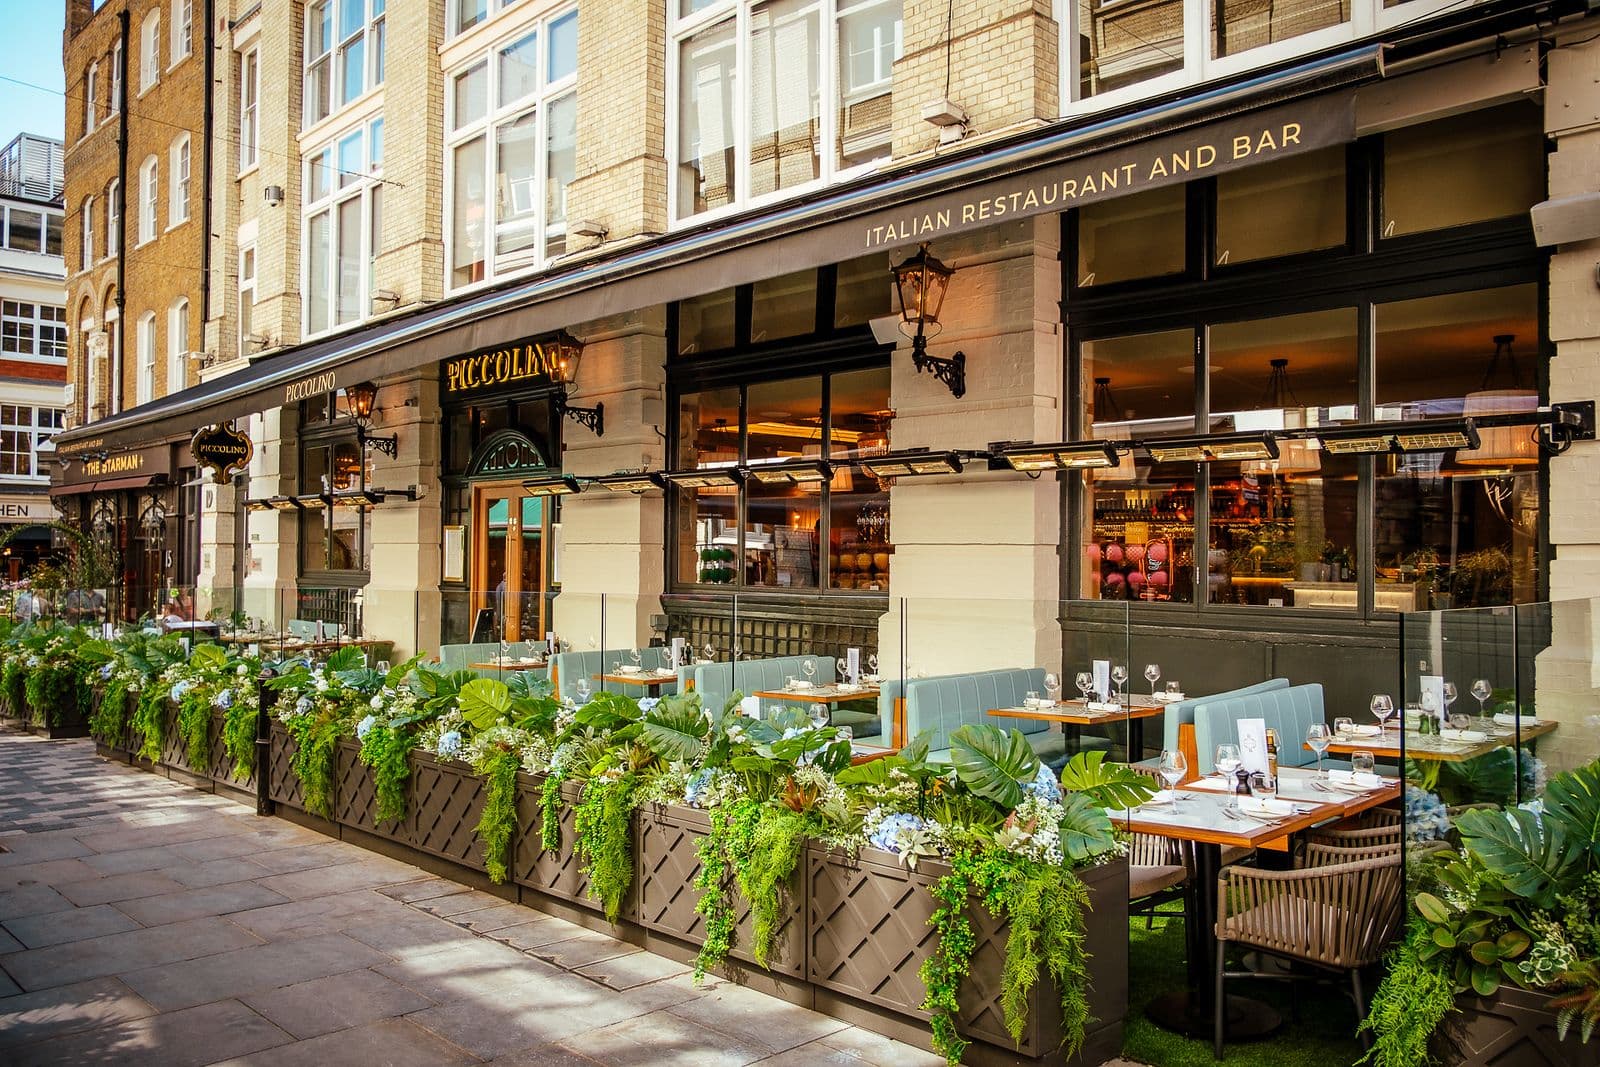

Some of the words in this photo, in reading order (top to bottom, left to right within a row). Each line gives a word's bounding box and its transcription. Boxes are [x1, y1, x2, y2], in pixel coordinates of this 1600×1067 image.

[865, 208, 951, 248] ITALIAN
[962, 163, 1137, 224] RESTAURANT
[1149, 144, 1217, 180] AND
[1232, 122, 1303, 160] BAR
[285, 371, 336, 402] PICCOLINO
[200, 444, 247, 454] PICCOLINO
[87, 461, 100, 476] THE
[101, 454, 138, 474] STARMAN
